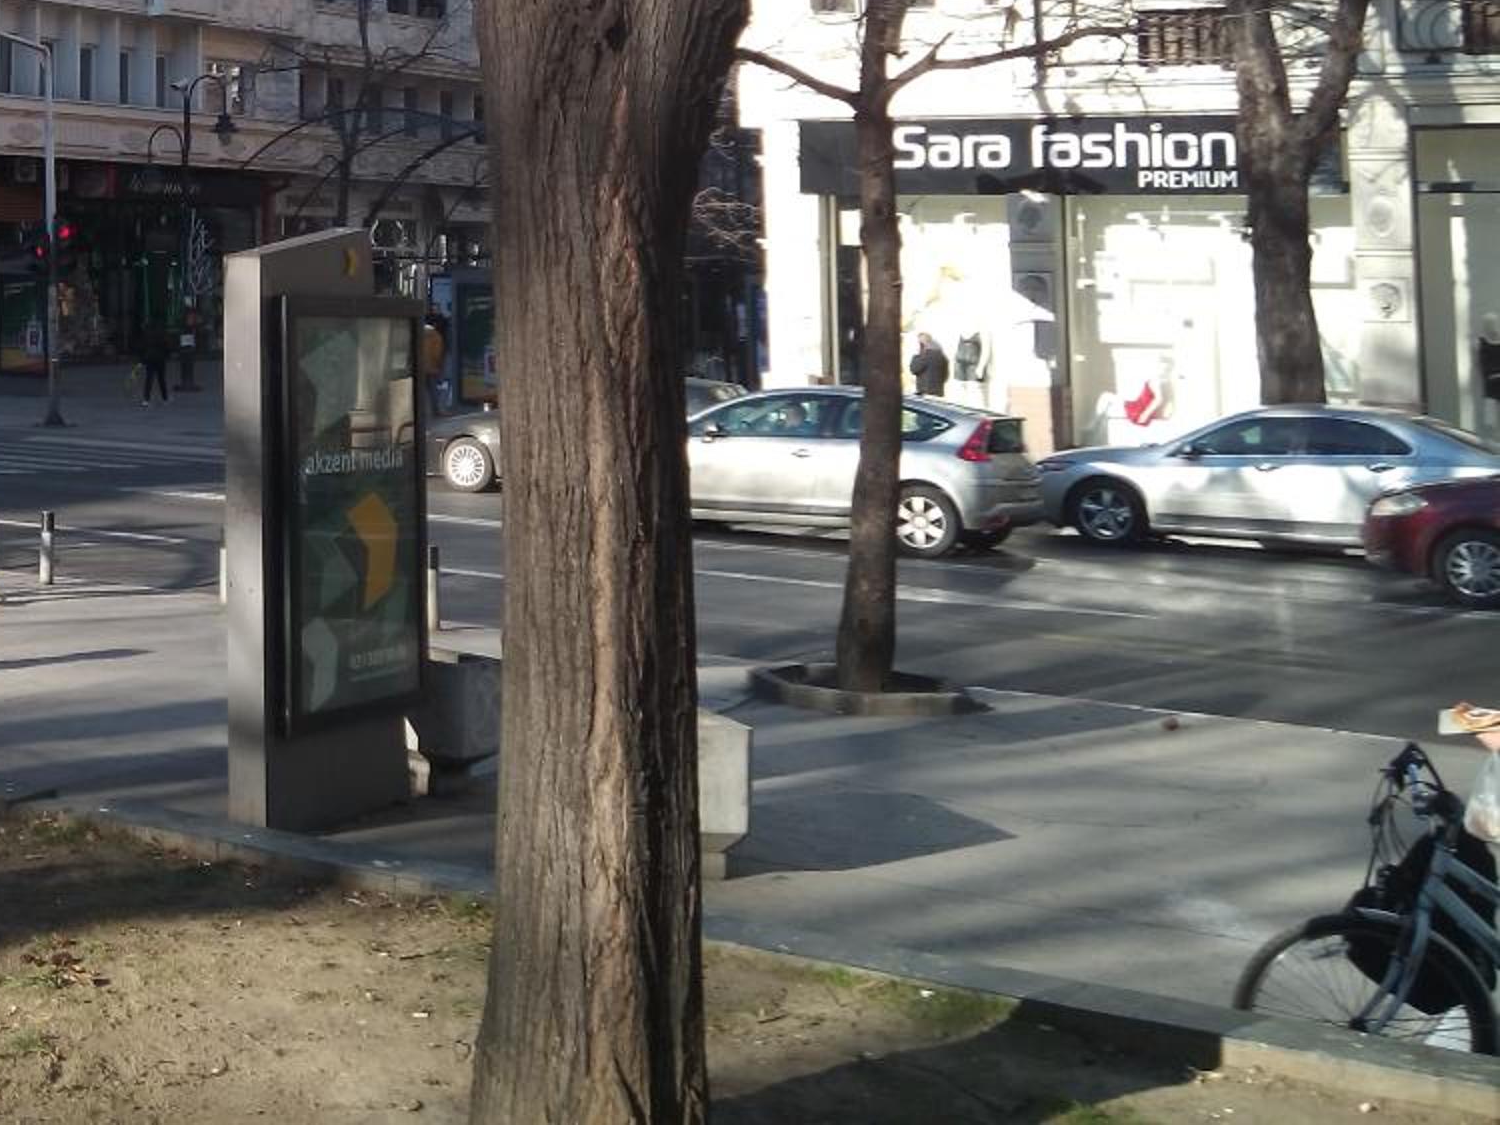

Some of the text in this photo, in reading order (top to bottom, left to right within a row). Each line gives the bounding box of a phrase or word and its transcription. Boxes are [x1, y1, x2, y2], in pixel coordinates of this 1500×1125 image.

[892, 122, 1237, 169] Sara fashion
[1137, 169, 1239, 189] PREMIUM
[305, 445, 404, 474] akzent media
